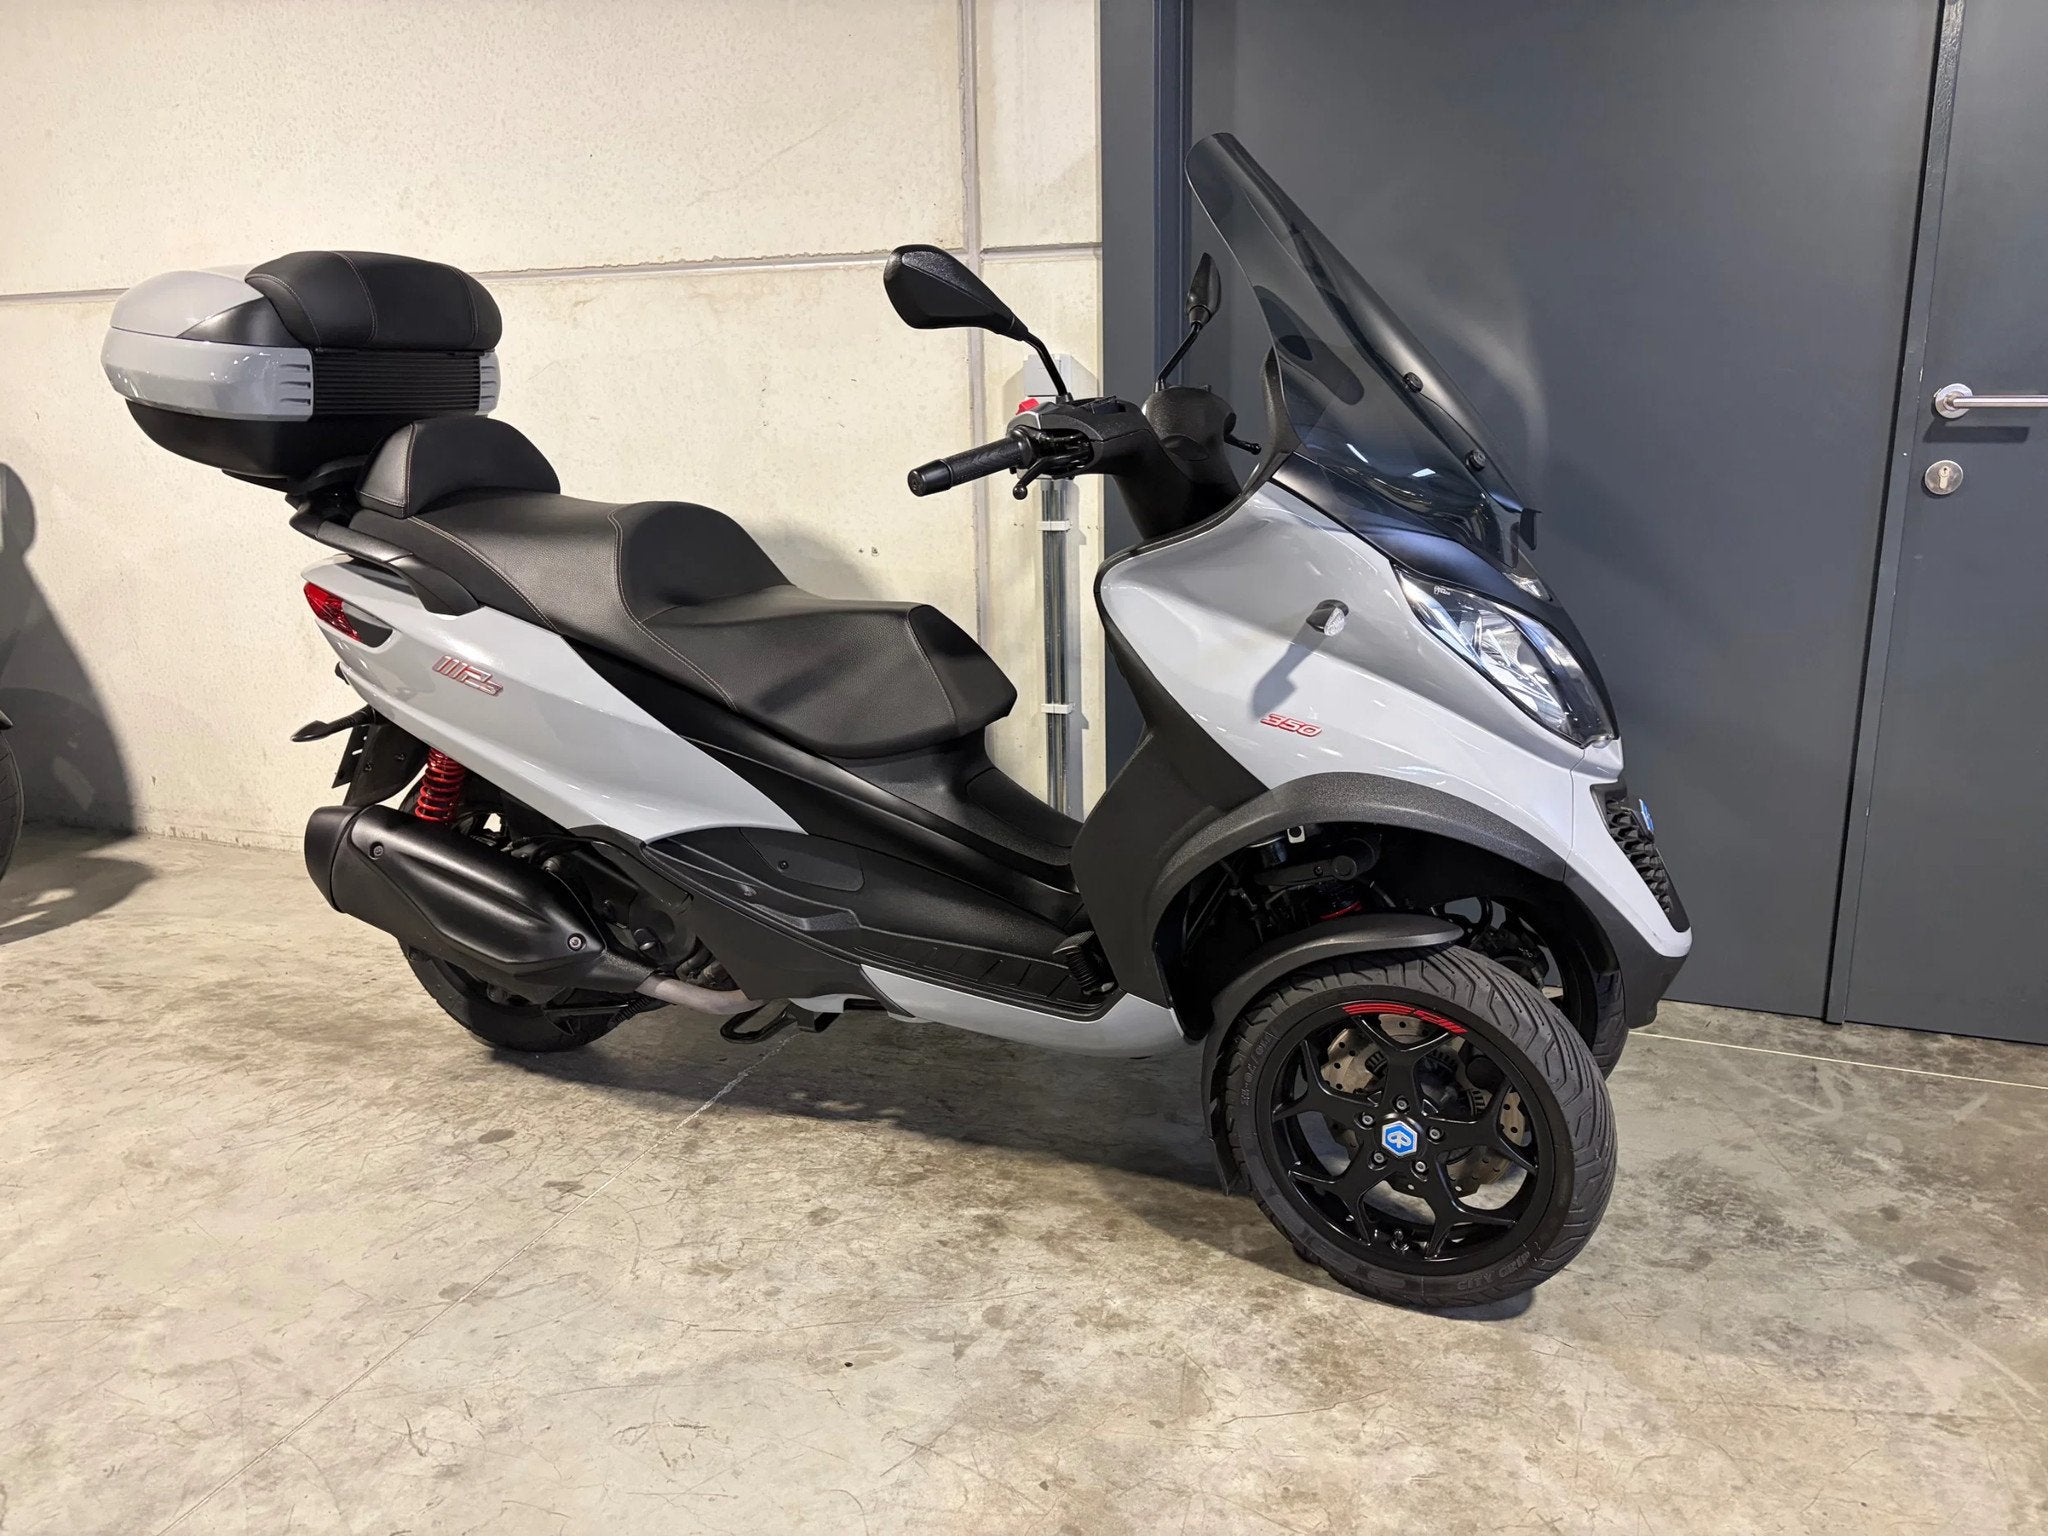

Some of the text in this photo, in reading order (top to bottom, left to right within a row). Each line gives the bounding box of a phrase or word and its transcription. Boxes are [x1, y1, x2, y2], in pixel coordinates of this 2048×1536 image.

[1260, 713, 1322, 737] 350
[1457, 1251, 1530, 1291] CITY GRIP
